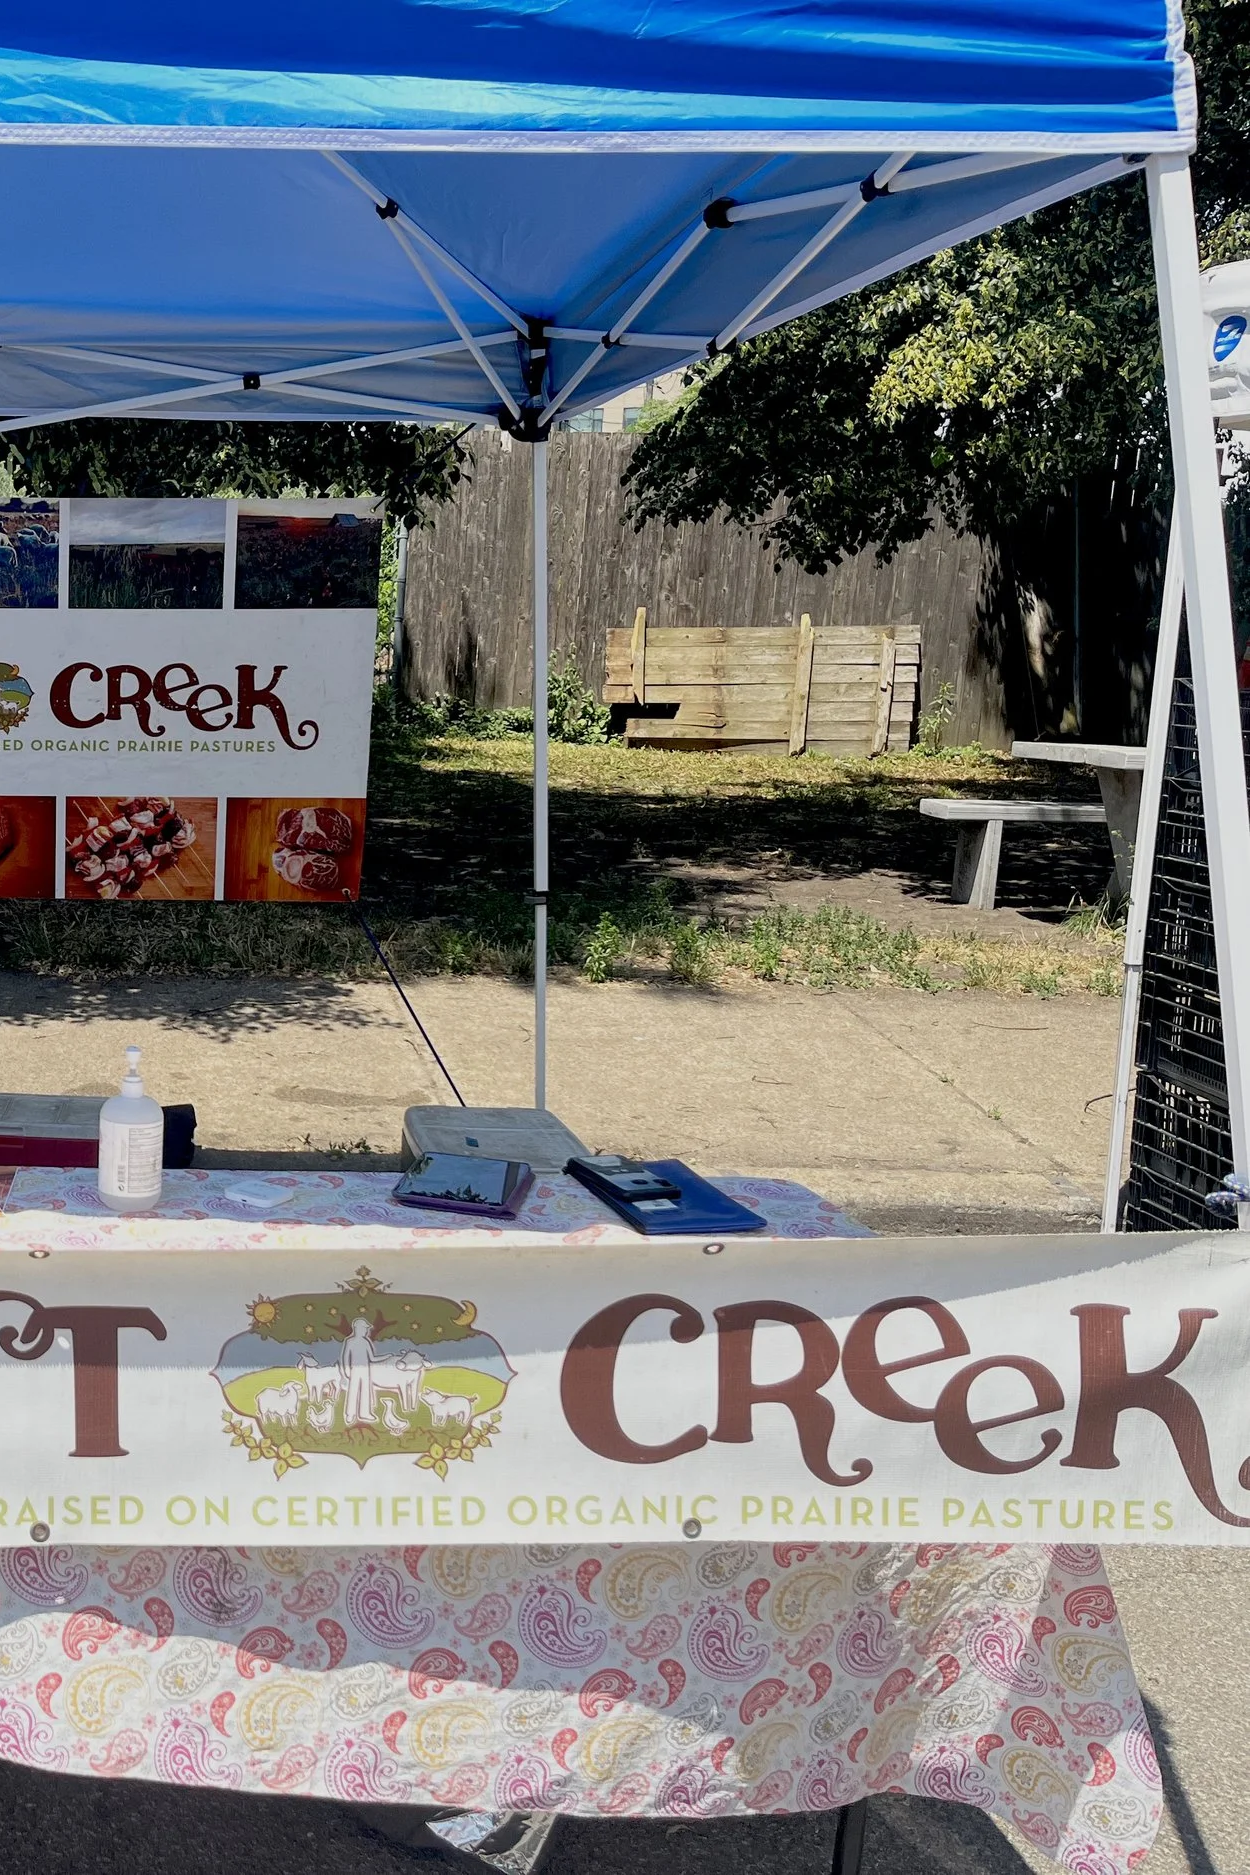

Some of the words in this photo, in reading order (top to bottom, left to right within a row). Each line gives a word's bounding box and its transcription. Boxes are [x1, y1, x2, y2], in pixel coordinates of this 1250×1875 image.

[31, 739, 111, 752] ORGANIC
[117, 740, 183, 752] PRAIRIE
[190, 741, 276, 753] PASTURES
[166, 1495, 230, 1526] ON
[251, 1495, 486, 1527] CERTIFIED
[507, 1495, 718, 1527] ORGANIC
[741, 1495, 920, 1527] PRAIRIE
[943, 1498, 1175, 1532] PASTURES
